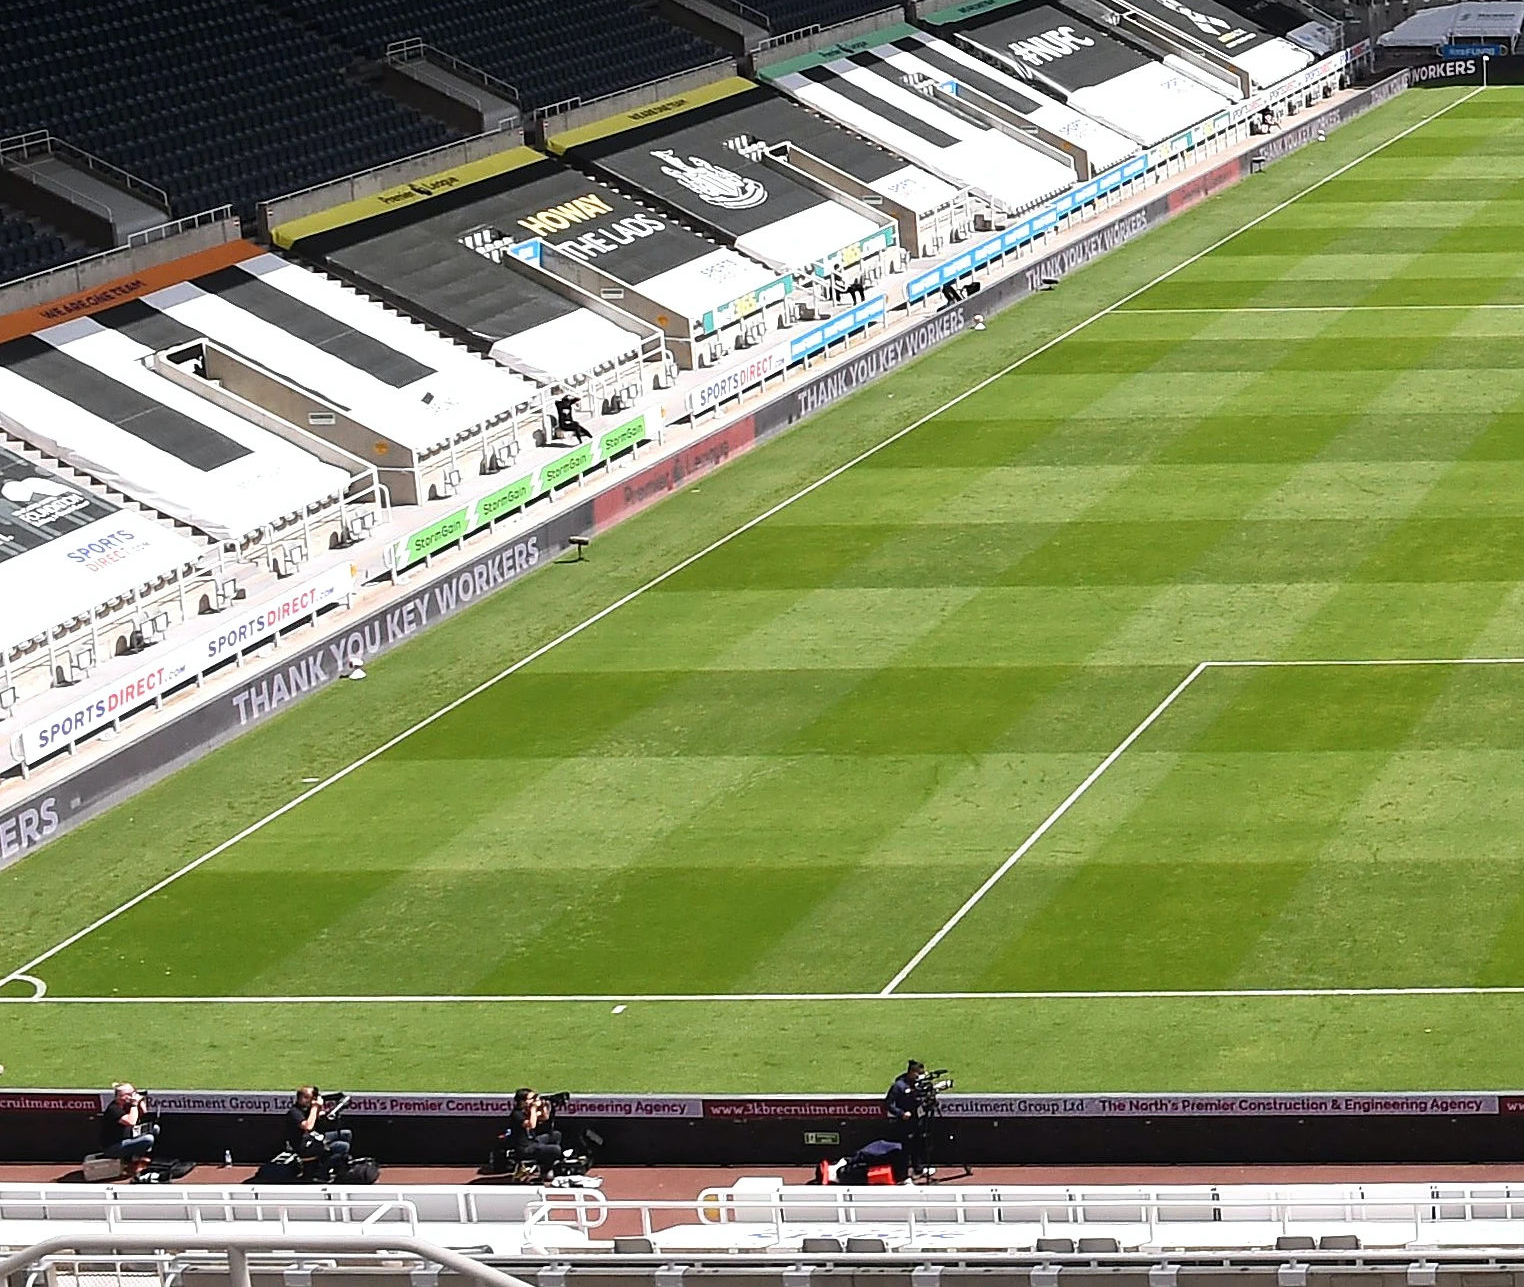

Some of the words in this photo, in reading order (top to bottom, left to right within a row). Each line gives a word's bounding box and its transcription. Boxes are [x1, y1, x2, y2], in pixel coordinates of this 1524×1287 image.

[1008, 26, 1095, 66] #NUFC
[518, 193, 614, 238] HOWAY
[617, 214, 666, 250] LADS
[798, 368, 850, 416] THANK
[849, 355, 877, 389] YOU
[877, 340, 904, 373] KEY
[905, 307, 965, 360] WORKERS
[605, 422, 644, 452] StormGain
[545, 452, 588, 483] StormGain
[482, 483, 528, 516] StormGain
[66, 529, 136, 563] SPORTS
[414, 519, 461, 552] StormGain
[232, 656, 328, 725] THANK
[331, 628, 381, 677] YOU
[388, 590, 431, 647] KEY
[434, 536, 541, 612] WORKERS
[146, 1097, 226, 1110] Recruitment
[230, 1097, 271, 1113] Group
[390, 1099, 443, 1112] Premier
[636, 1101, 686, 1116] Agency
[711, 1100, 880, 1115] www.3kbrecruitment.com
[1018, 1101, 1059, 1118] Group
[1062, 1101, 1084, 1115] Ltd
[1098, 1099, 1125, 1112] The
[1129, 1099, 1178, 1112] North's
[1182, 1099, 1236, 1112] Premier
[1239, 1098, 1327, 1111] Construction
[1331, 1098, 1342, 1111] &
[1345, 1098, 1427, 1114] Engineering
[1430, 1098, 1482, 1114] Agency
